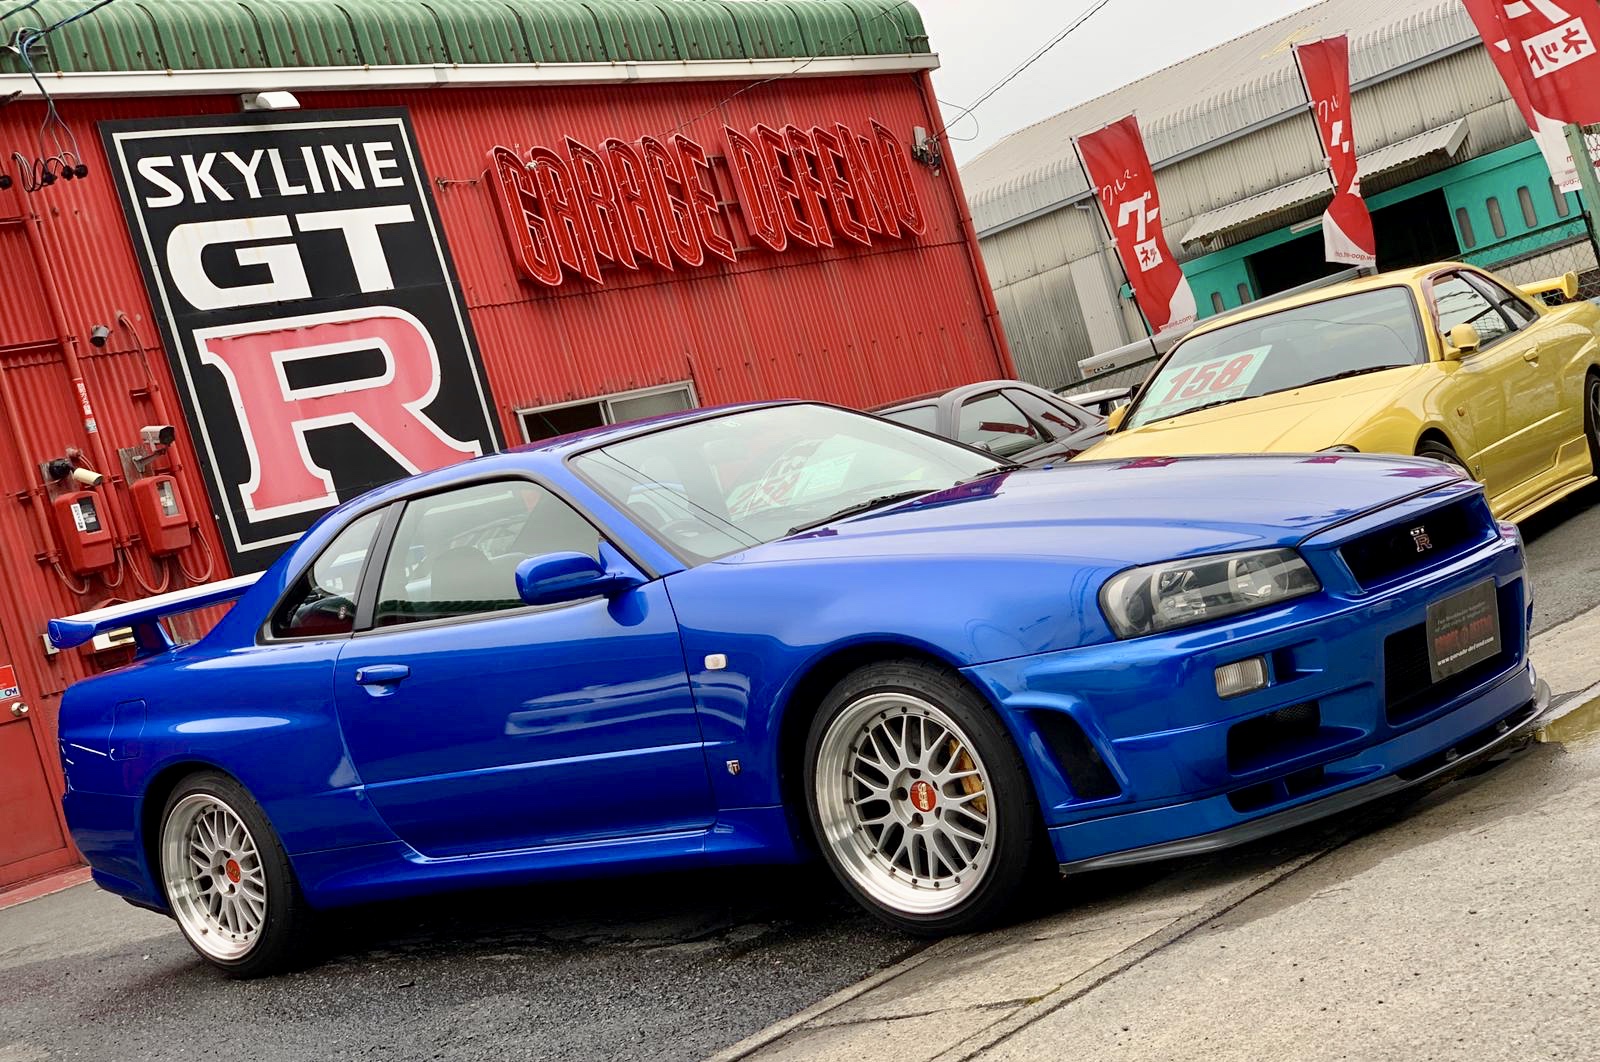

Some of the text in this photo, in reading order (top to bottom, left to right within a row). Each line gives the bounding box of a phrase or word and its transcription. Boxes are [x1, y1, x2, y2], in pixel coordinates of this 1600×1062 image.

[136, 142, 405, 208] SKYLINE
[491, 117, 927, 287] GARAGE DEFEND
[166, 205, 415, 311] GT
[192, 307, 484, 523] R
[1161, 353, 1256, 404] 158
